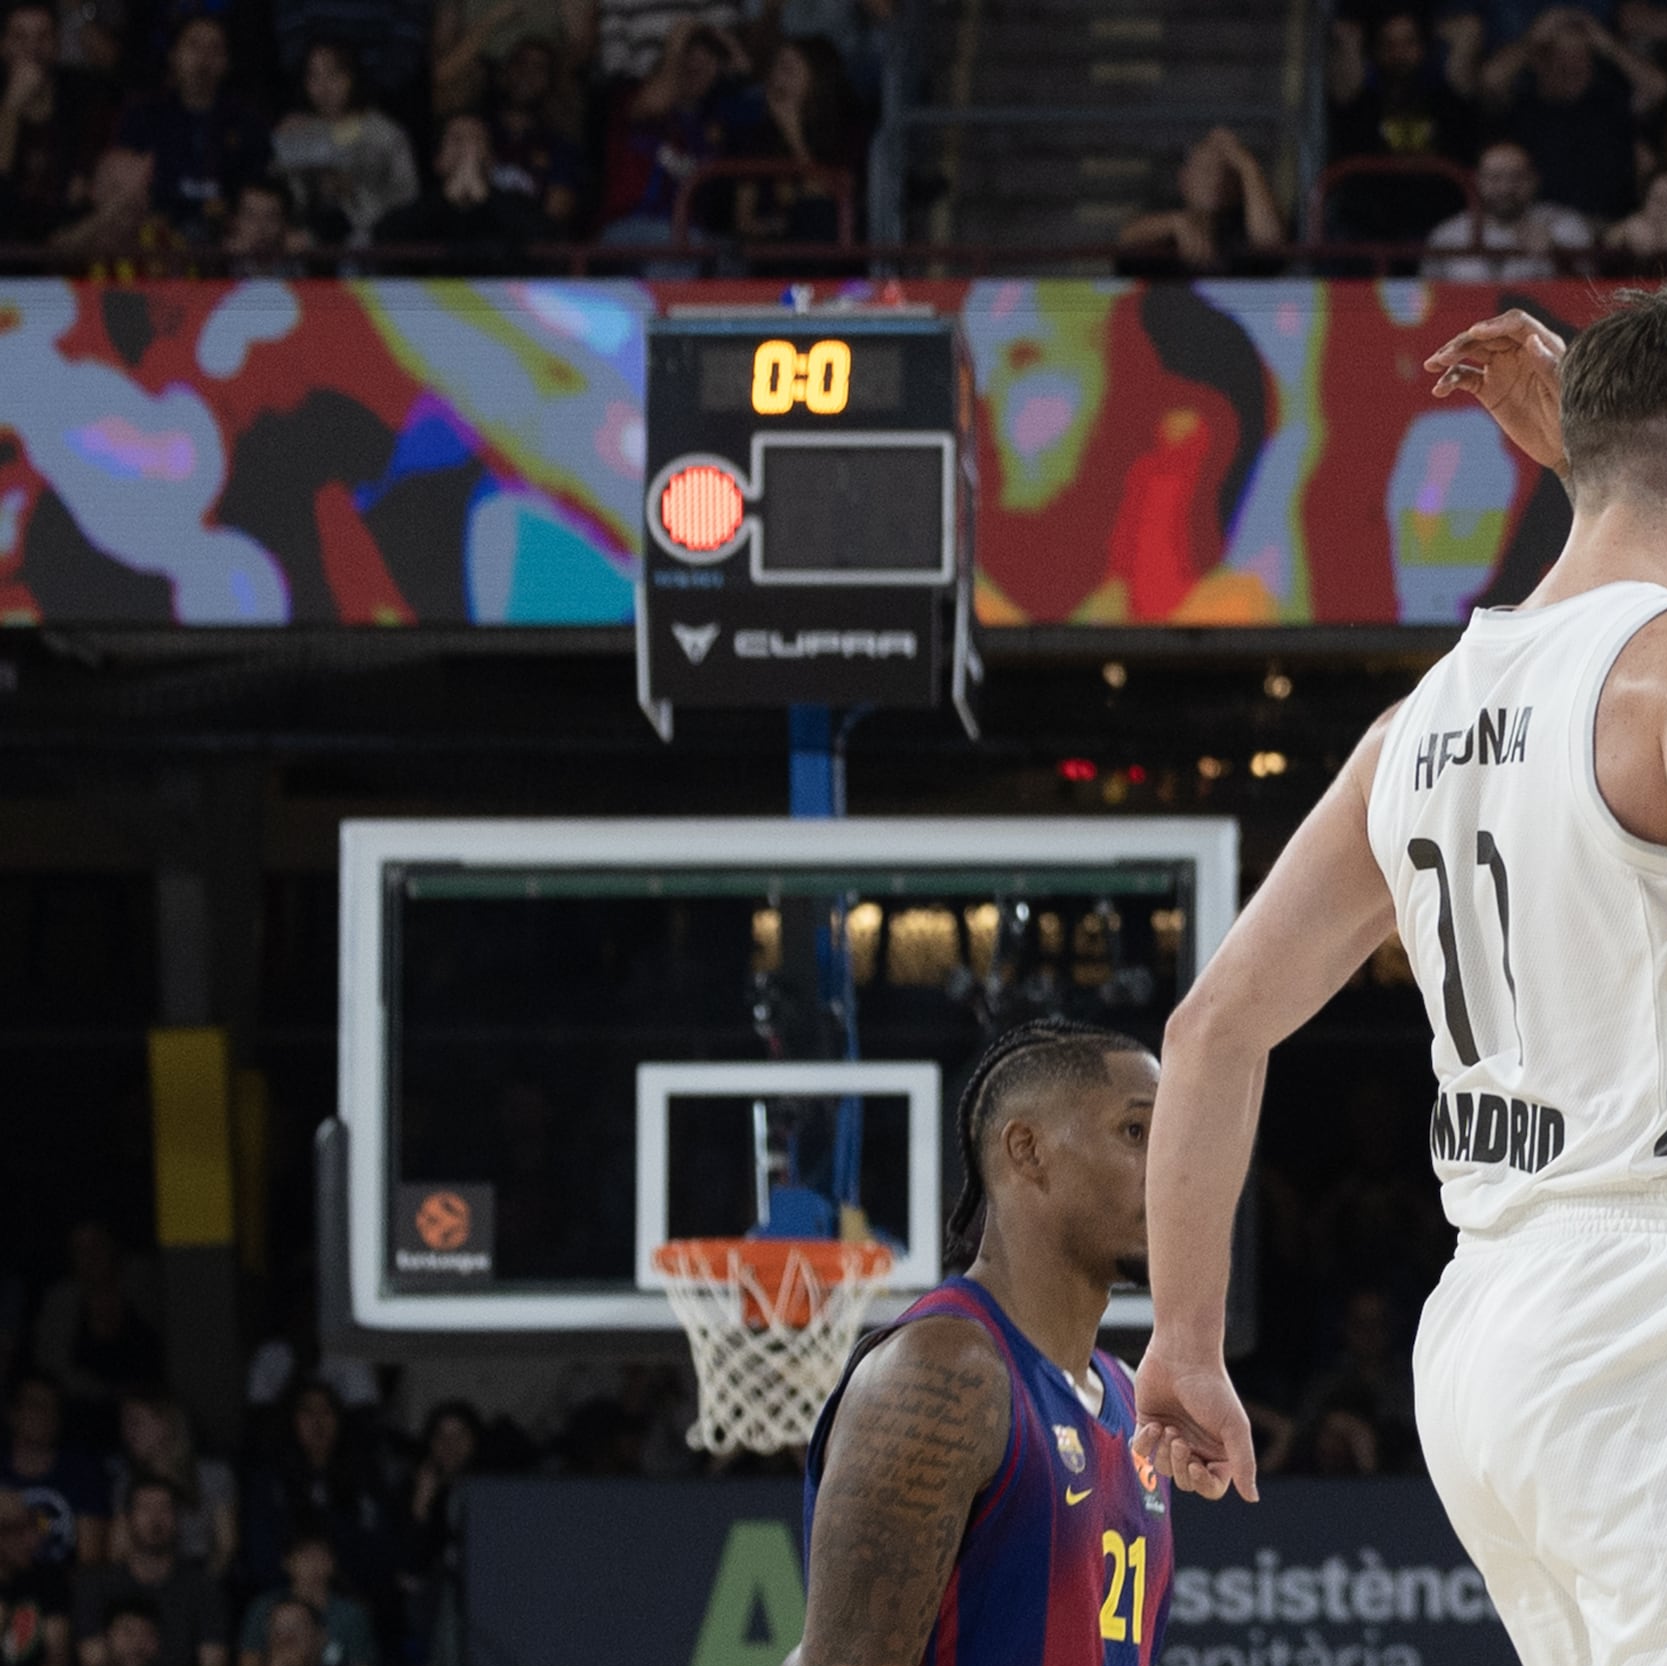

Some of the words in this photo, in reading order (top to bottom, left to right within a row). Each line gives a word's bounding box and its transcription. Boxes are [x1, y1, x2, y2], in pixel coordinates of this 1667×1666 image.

[752, 339, 851, 414] 0:0
[1407, 830, 1524, 1067] 11
[1430, 1091, 1565, 1174] MADRID
[1100, 1529, 1146, 1645] 21
